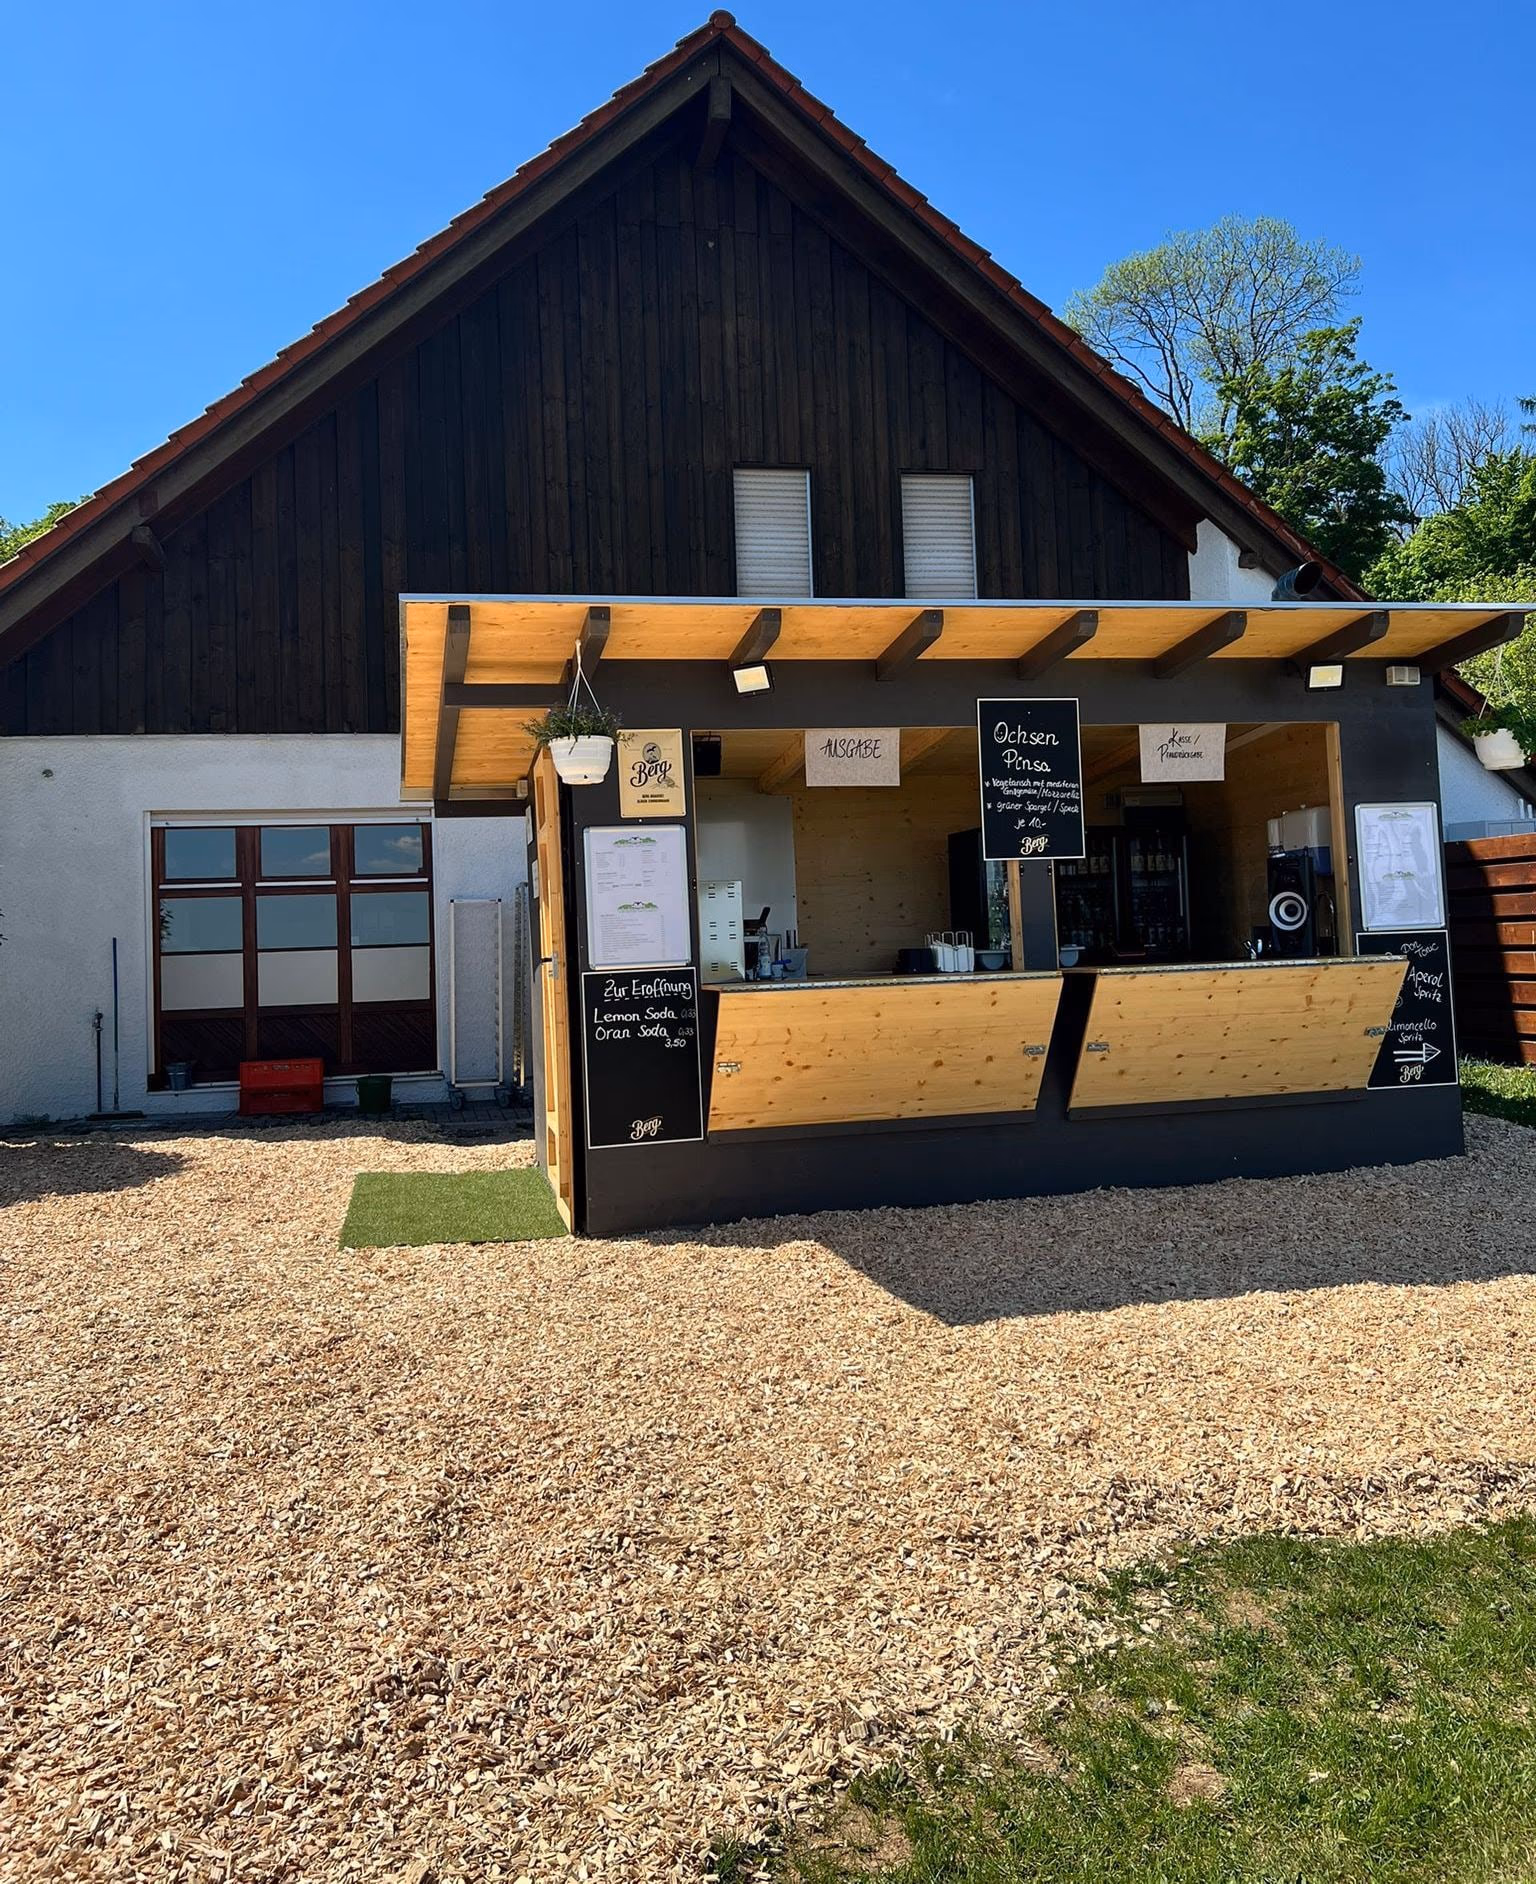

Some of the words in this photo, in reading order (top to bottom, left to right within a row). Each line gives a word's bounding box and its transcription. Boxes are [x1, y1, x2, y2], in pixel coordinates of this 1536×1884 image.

[994, 721, 1059, 746] Ochsen
[819, 738, 882, 759] AUSGABE
[1001, 748, 1051, 772] Pinsa
[630, 760, 672, 787] Berg
[1014, 818, 1026, 830] je
[1020, 836, 1048, 855] Berg
[1407, 965, 1443, 988] Aperol
[604, 979, 629, 998] Zur
[1413, 985, 1442, 1003] Spritz
[594, 1007, 640, 1024] Lemon
[644, 1006, 678, 1020] Soda
[595, 1026, 631, 1041] Oran
[637, 1023, 669, 1038] Soda
[1387, 1018, 1438, 1032] Limoncello
[664, 1038, 687, 1049] 3,50
[1398, 1032, 1424, 1044] Spritz
[1400, 1064, 1425, 1083] Berg
[630, 1118, 662, 1141] Berg
